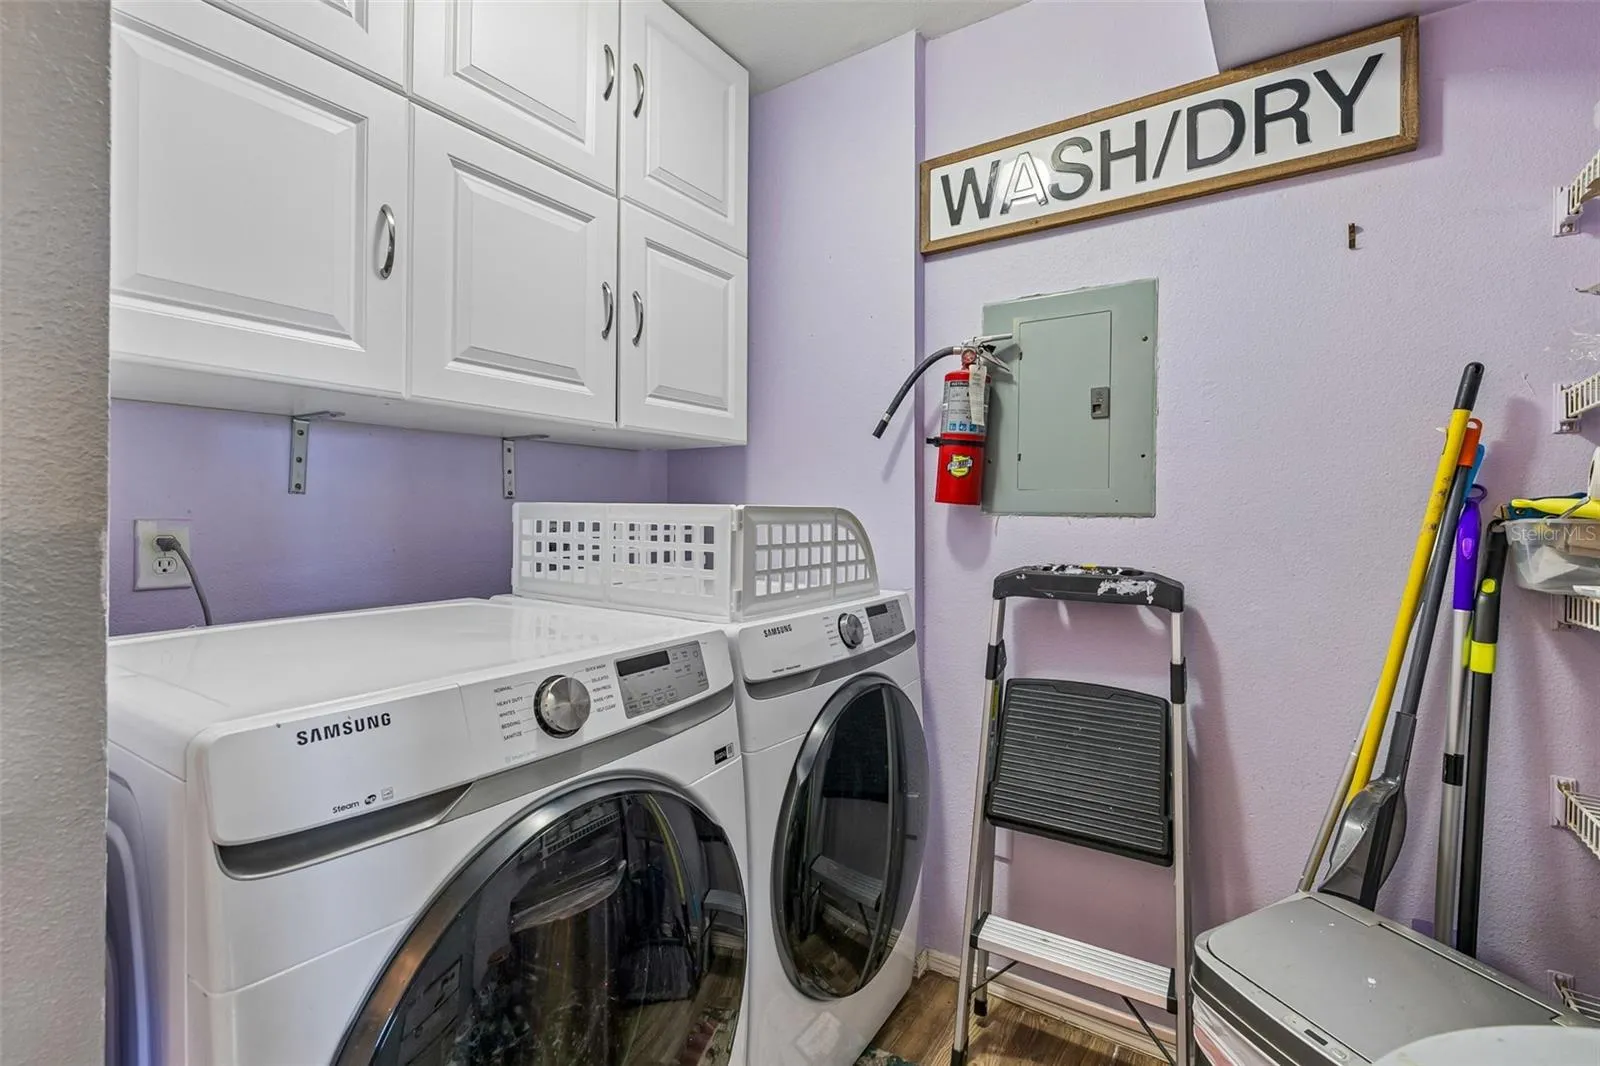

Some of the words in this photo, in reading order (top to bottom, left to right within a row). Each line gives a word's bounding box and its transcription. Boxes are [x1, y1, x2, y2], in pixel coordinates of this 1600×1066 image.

[940, 52, 1385, 227] WASH/DRY
[763, 624, 792, 637] SAMSUNG
[297, 713, 391, 746] SAMSUNG
[332, 800, 360, 814] Steam
